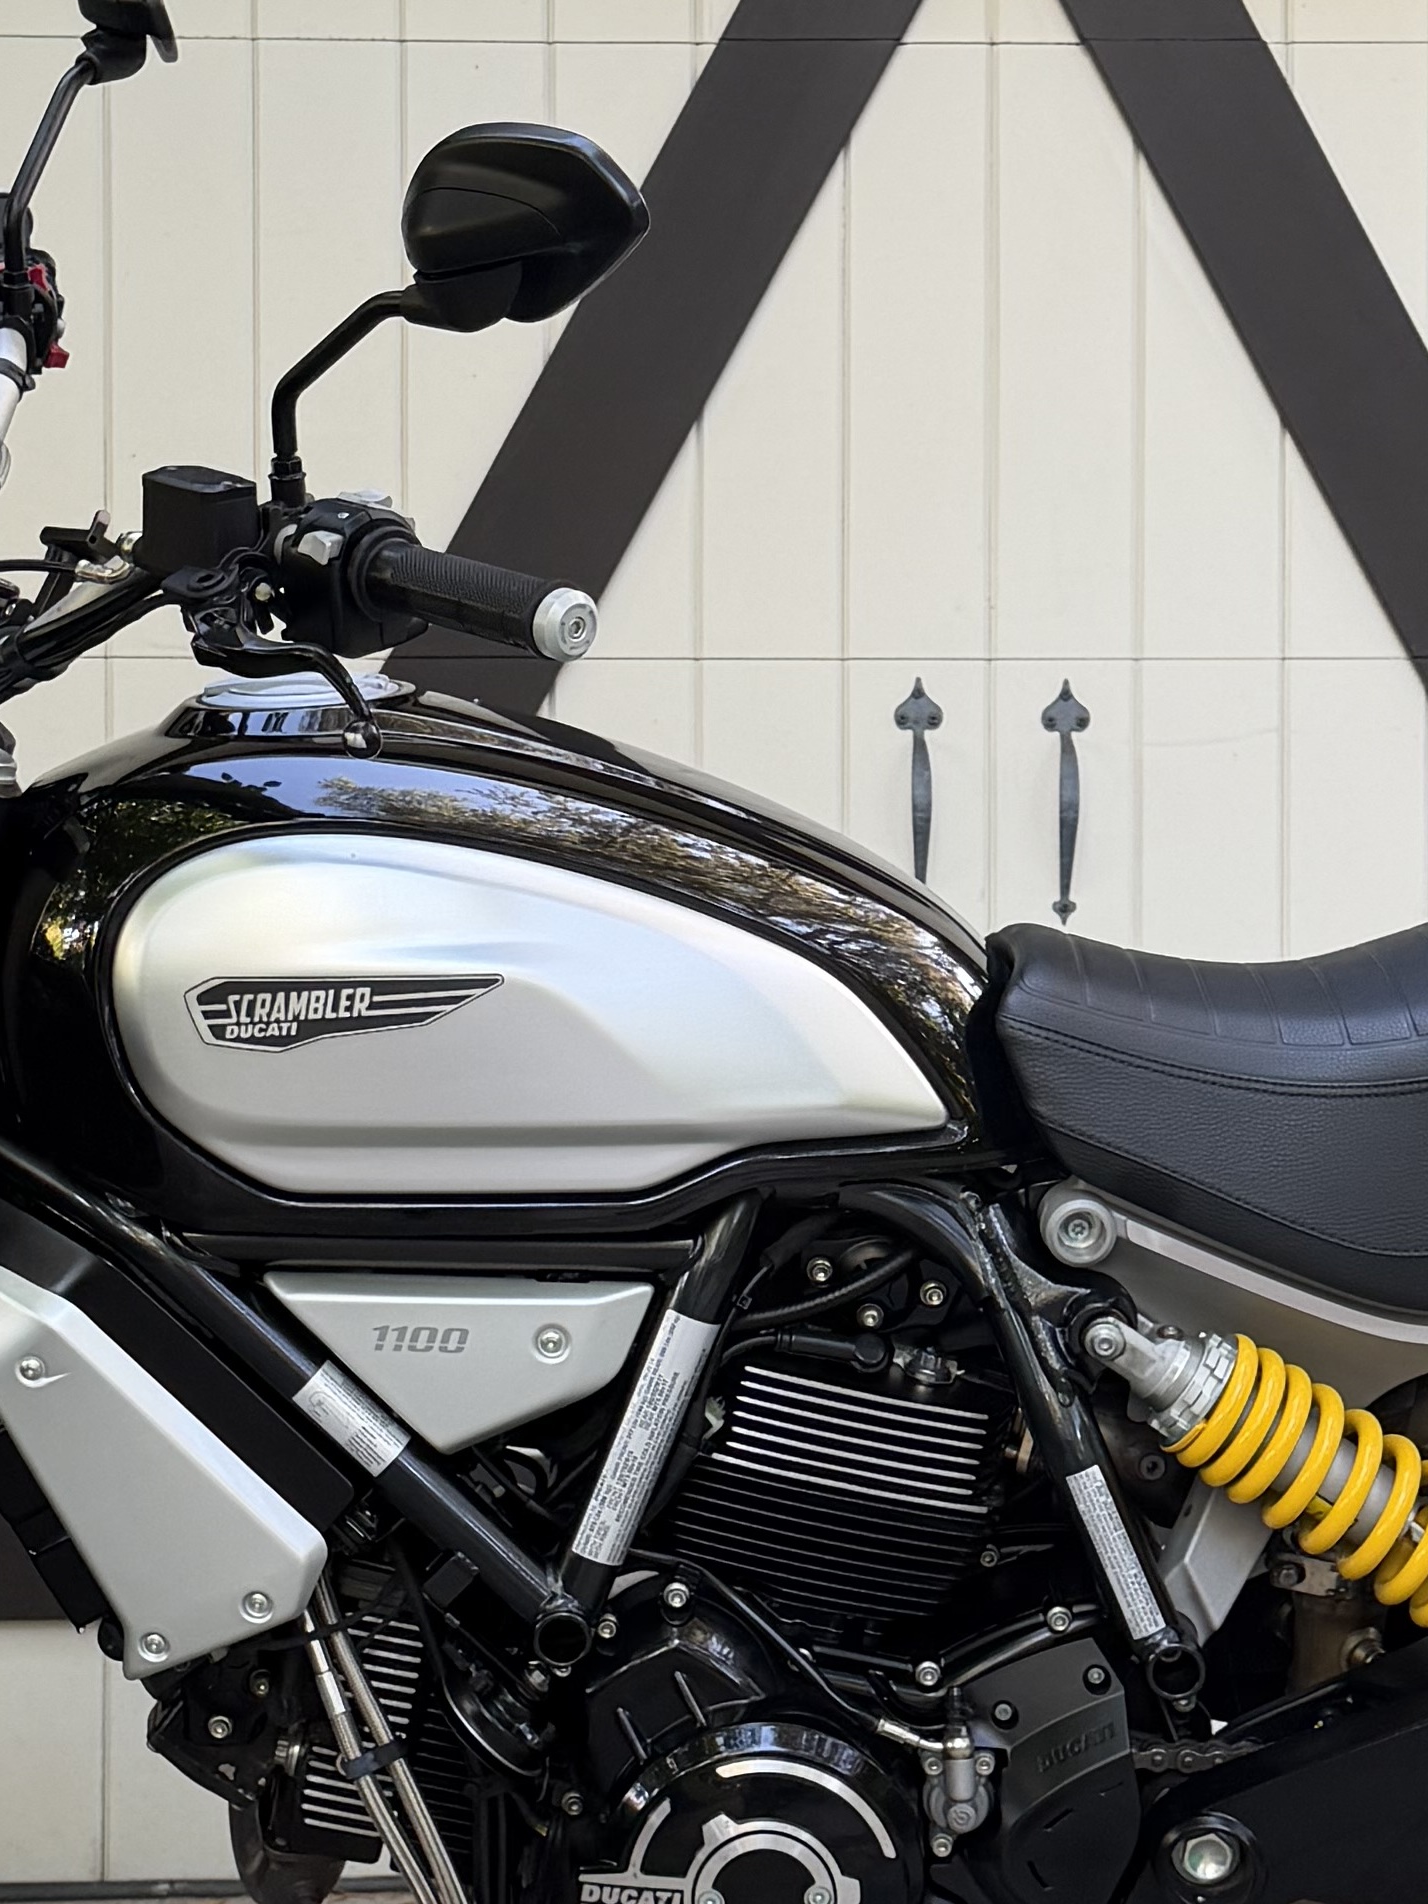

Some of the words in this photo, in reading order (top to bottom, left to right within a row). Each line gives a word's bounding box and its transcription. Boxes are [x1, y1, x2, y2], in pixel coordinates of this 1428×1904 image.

[226, 987, 371, 1024] SCRAMBLER
[225, 1022, 297, 1039] DUCATI
[372, 1325, 469, 1353] 1100
